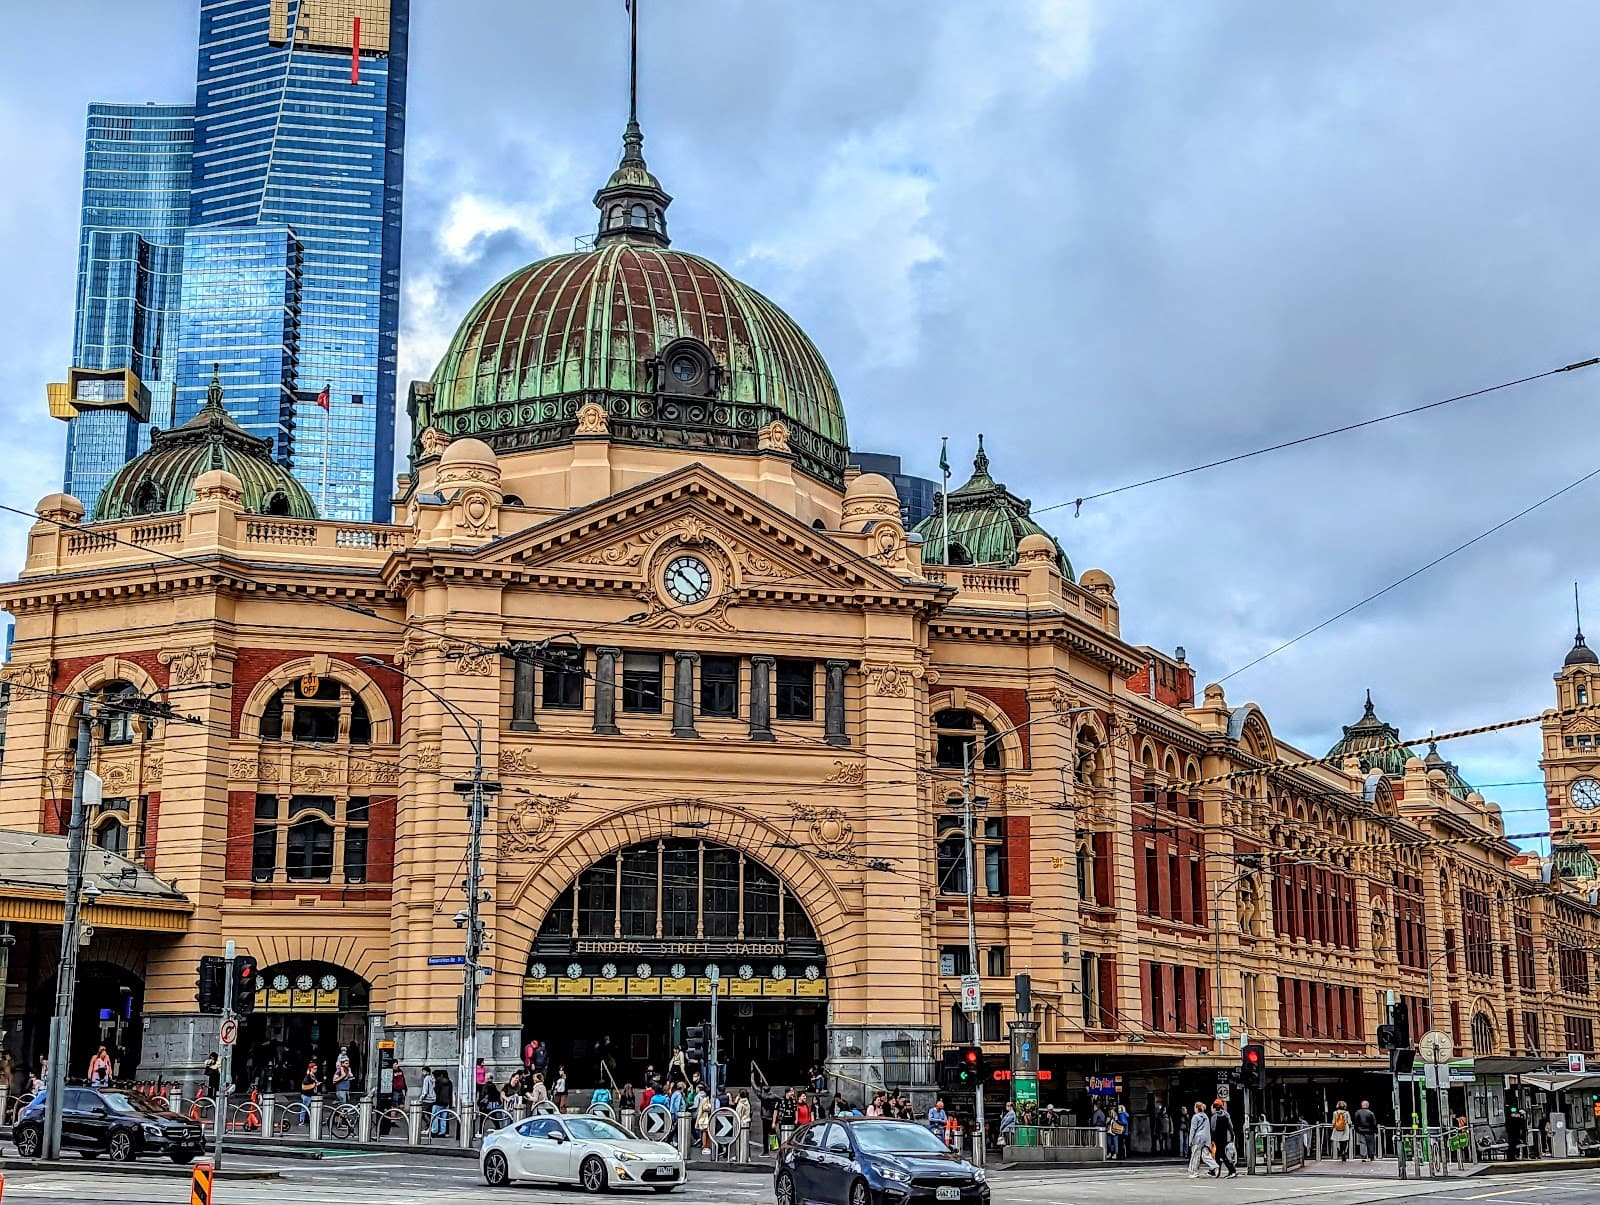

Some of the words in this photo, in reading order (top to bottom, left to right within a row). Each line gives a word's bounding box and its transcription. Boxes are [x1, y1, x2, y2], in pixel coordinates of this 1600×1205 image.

[303, 675, 317, 685] CUT
[303, 686, 317, 694] OFF
[576, 941, 643, 954] FLINDERS
[660, 942, 710, 954] STREET
[725, 943, 785, 955] STATION
